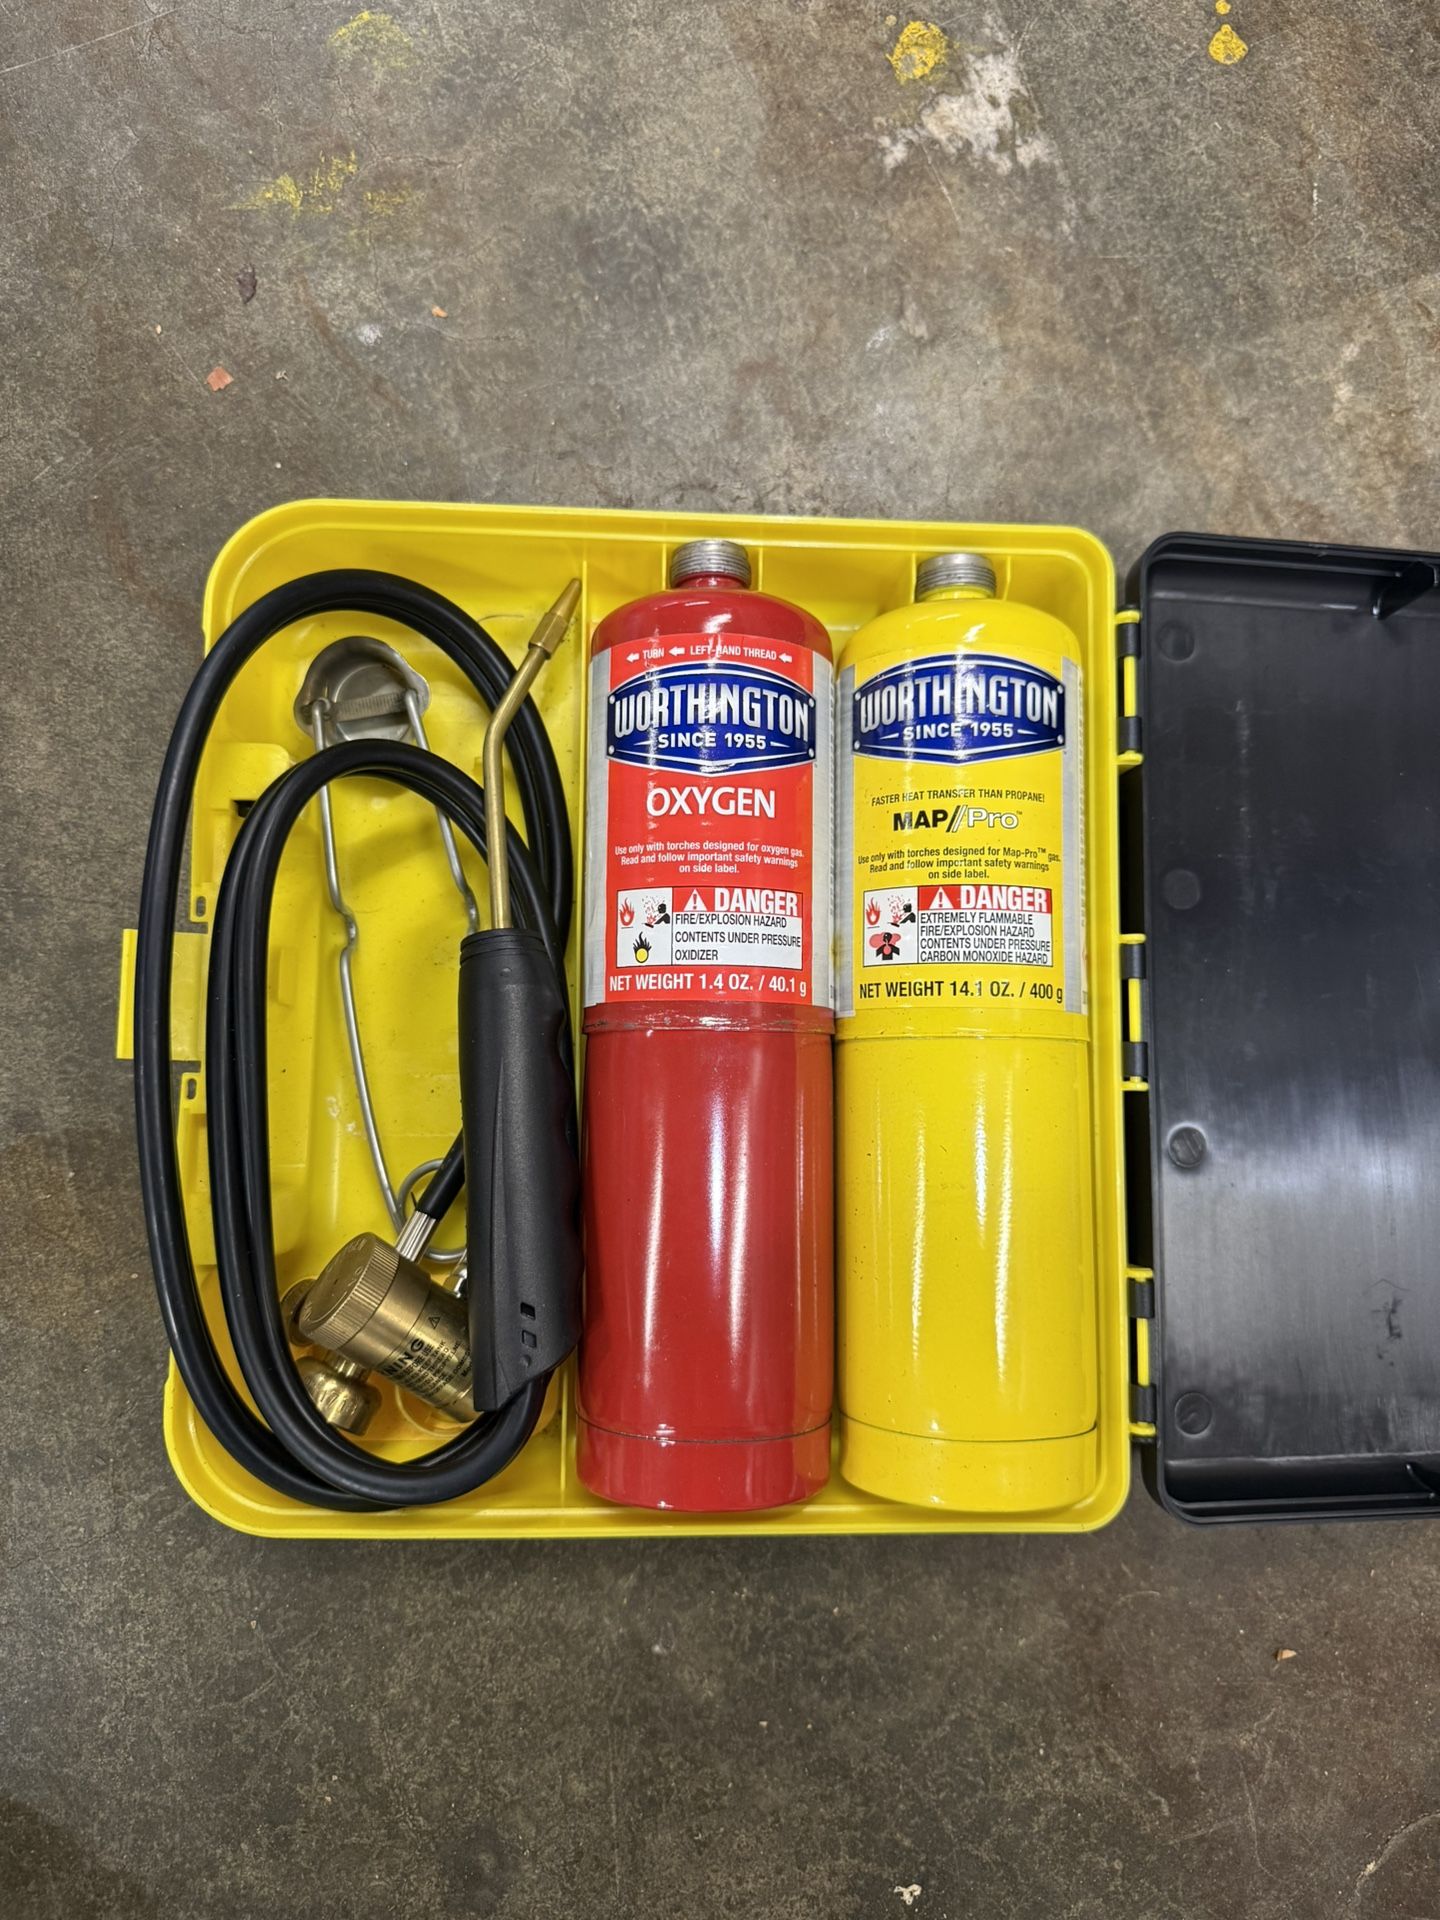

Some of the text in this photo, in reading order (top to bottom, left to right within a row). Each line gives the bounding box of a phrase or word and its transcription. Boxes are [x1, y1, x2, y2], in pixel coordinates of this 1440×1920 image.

[642, 645, 777, 660] TURN LEFT-HAND THREAD
[614, 683, 809, 742] WORTHINGTON
[860, 674, 1058, 734] WORTHINGTON
[902, 722, 1014, 740] SINCE 1955
[657, 732, 767, 750] SINCE 1955
[646, 786, 776, 818] OXYGEN
[871, 788, 1045, 807] FASTER HEAT TRANSFER THAN PROPANE!
[615, 840, 805, 858] Use only with torches designed for oxygen gas.
[858, 855, 870, 865] Use
[871, 852, 886, 863] only
[887, 849, 905, 860] with
[907, 847, 940, 858] torches
[943, 846, 985, 858] designed
[988, 846, 1001, 856] for
[1048, 853, 1061, 863] gas.
[621, 851, 799, 870] Read and follow important safety warnings
[679, 863, 741, 874] on side label.
[869, 858, 1050, 873] Read and follow important safety warnings
[928, 869, 990, 879] on side label.
[714, 887, 798, 917] DANGER
[960, 885, 1047, 913] DANGER
[675, 913, 787, 929] FIRE/EXPLOSION HAZARD
[920, 912, 1033, 926] EXTREMELY FLAMMABLE
[675, 931, 801, 948] CONTENTS UNDER PRESSURE
[920, 925, 1035, 938] FIRE/EXPLOSION HAZARD
[920, 938, 1050, 952] CONTENTS UNDER PRESSURE
[675, 949, 718, 961] OXIDIZER
[920, 950, 1048, 965] CARBON MONOXIDE HAZARD
[609, 974, 807, 997] NET WEIGHT 1.4 OZ. / 40.1 g
[860, 981, 1063, 1003] NET WEIGHT 14.1 OZ. / 400 g
